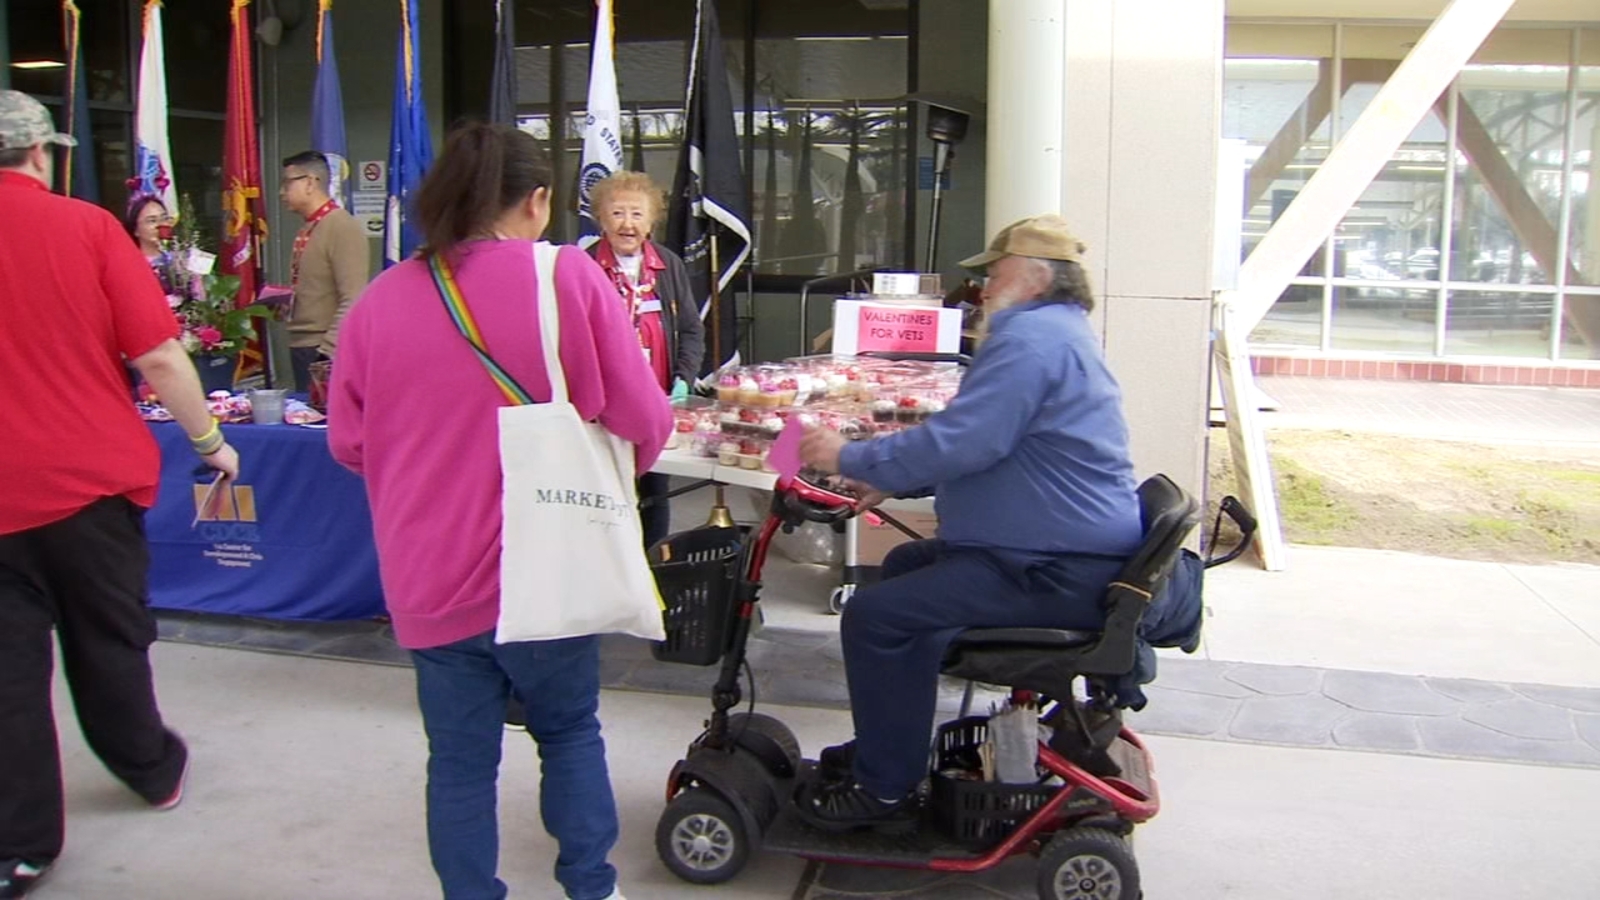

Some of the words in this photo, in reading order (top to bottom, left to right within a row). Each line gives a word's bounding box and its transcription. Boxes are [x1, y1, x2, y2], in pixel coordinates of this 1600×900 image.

[864, 311, 933, 326] VALENTINES
[870, 327, 894, 339] FOR
[898, 330, 925, 341] VETS
